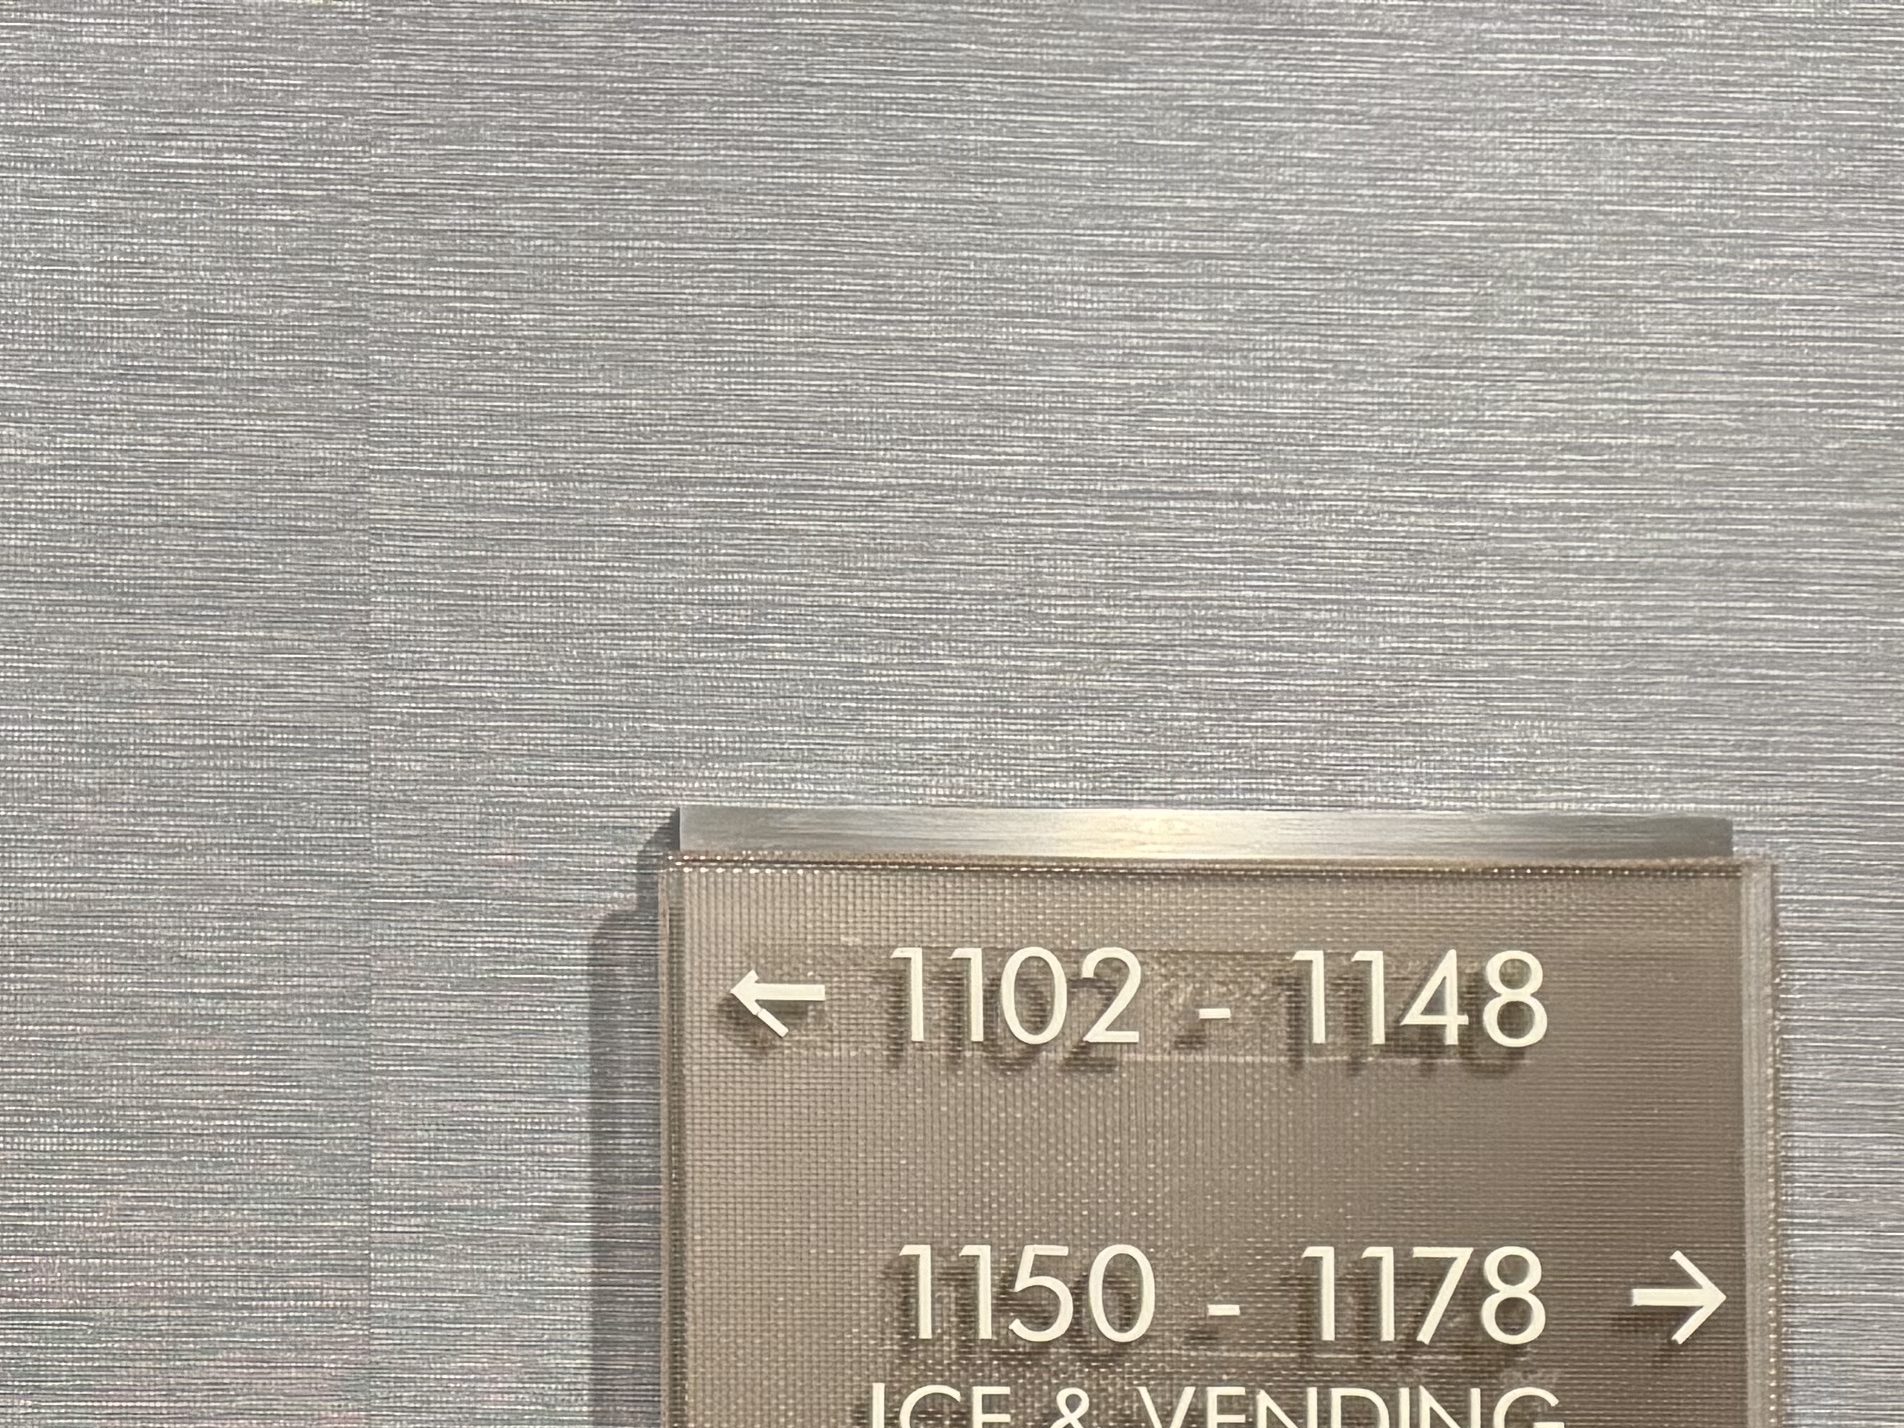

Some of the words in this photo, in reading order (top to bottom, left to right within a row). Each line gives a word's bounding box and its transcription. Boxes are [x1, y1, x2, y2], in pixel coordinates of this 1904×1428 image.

[889, 944, 1142, 1047] 1102
[1290, 947, 1550, 1050] 1148
[898, 1242, 1157, 1345] 1150
[1300, 1245, 1549, 1347] 1178
